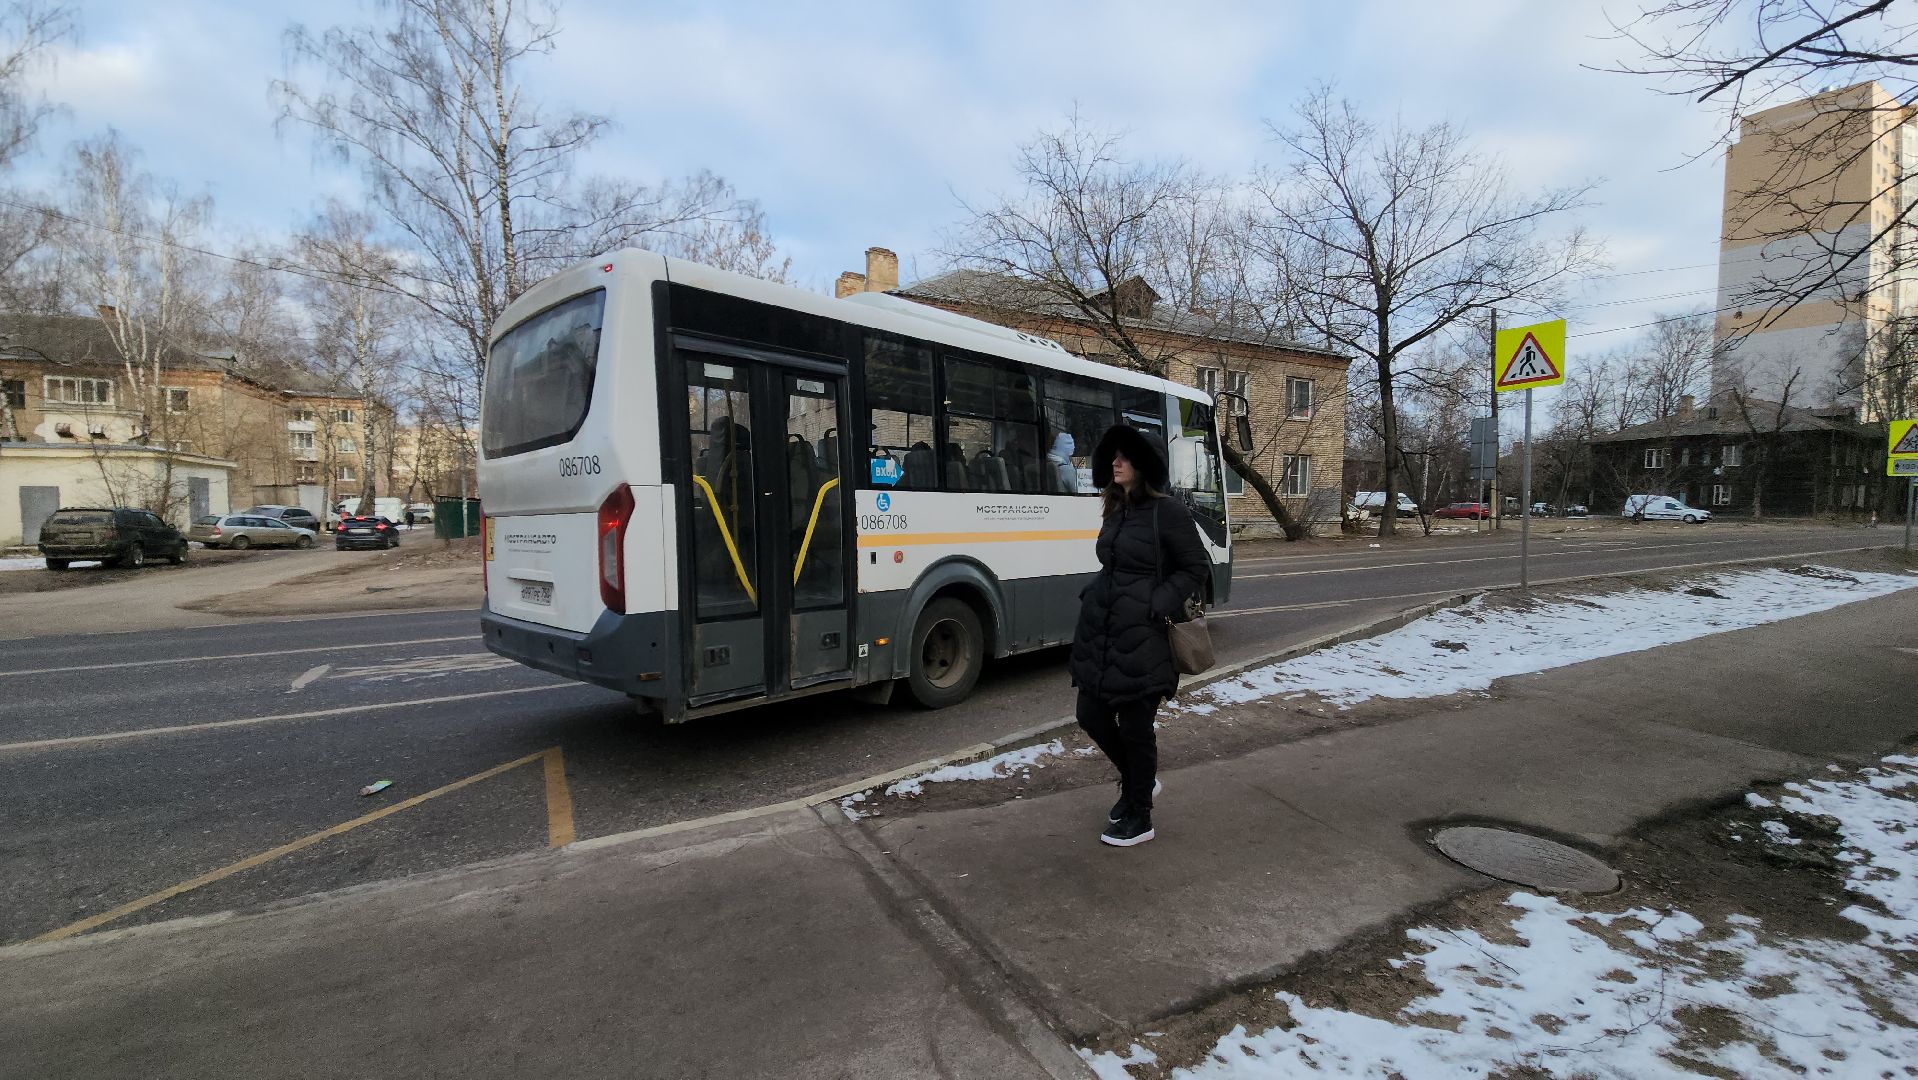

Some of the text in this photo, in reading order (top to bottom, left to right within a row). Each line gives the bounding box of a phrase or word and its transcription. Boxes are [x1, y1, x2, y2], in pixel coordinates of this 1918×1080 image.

[559, 455, 601, 477] 086708
[976, 505, 1050, 514] МОСТРАНСАВТО
[861, 514, 908, 530] 086708
